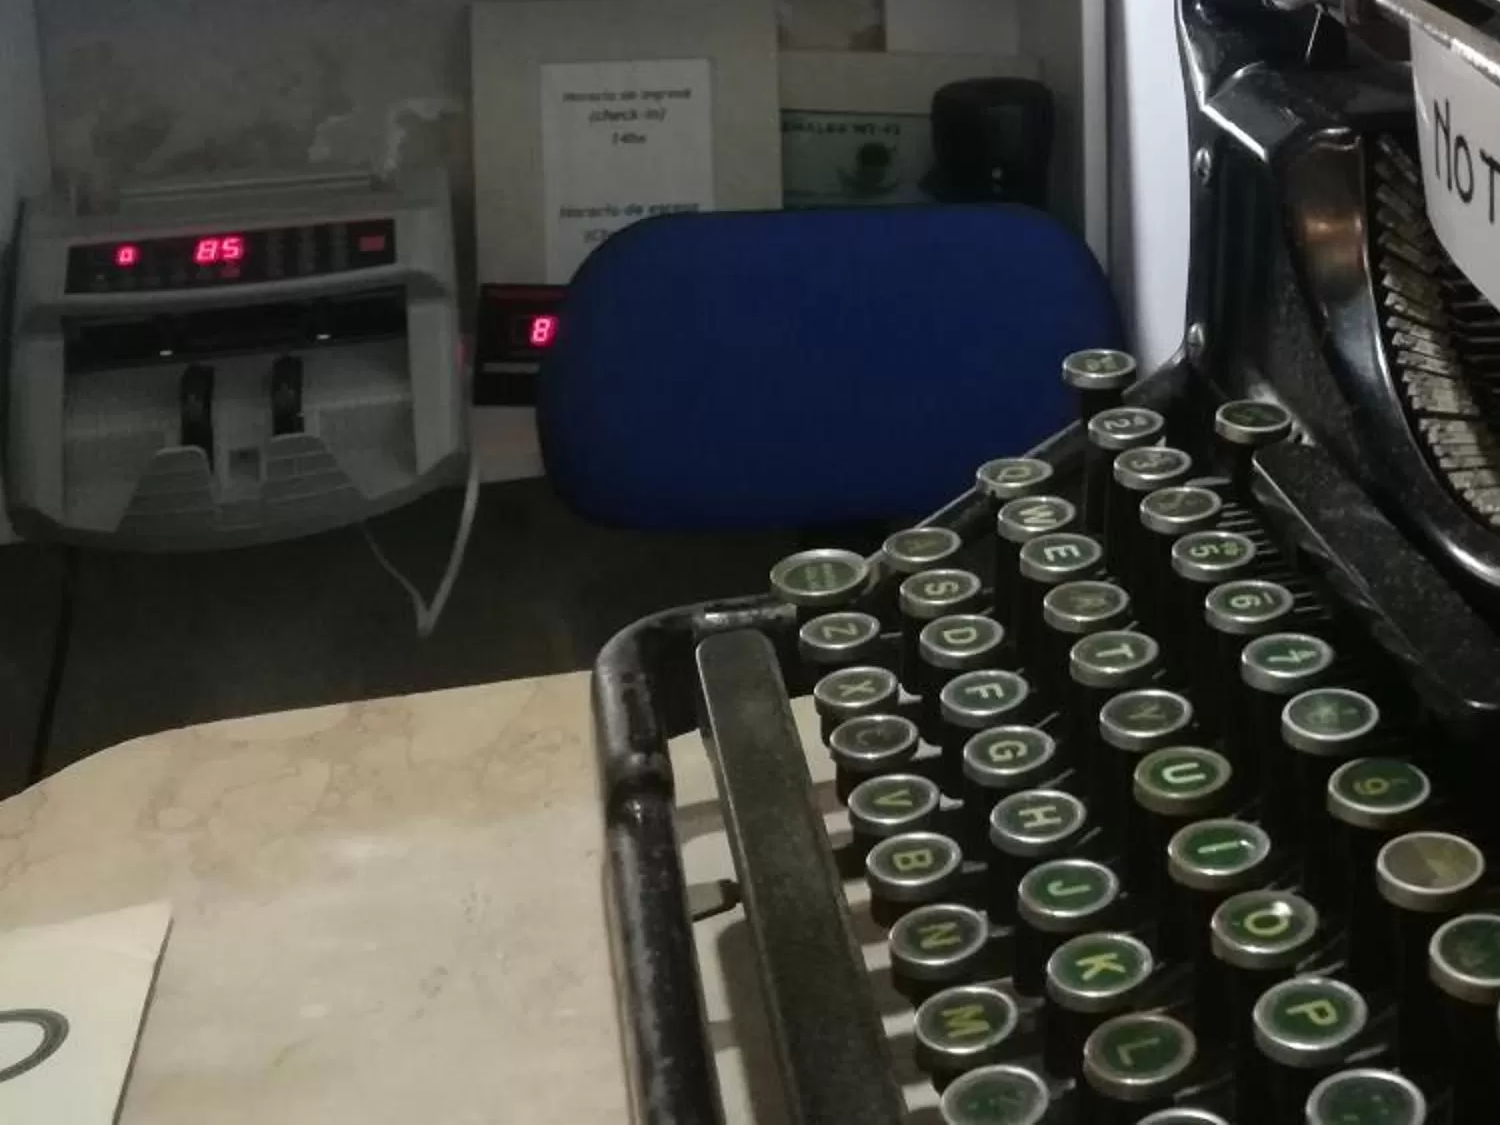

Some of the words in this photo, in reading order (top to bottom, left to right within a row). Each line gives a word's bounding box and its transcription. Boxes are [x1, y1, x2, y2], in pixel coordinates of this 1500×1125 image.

[1433, 97, 1476, 205] NO
[195, 236, 244, 263] 85
[531, 316, 557, 345] 8
[1043, 543, 1082, 562] E
[965, 682, 1004, 700] F
[988, 739, 1029, 763] G
[1161, 761, 1207, 785] U
[873, 788, 913, 807] V
[1018, 805, 1062, 828] H
[892, 848, 934, 871] B
[917, 921, 962, 949] N
[1075, 952, 1127, 982] K
[941, 1003, 991, 1038] M
[1285, 999, 1338, 1026] P
[1115, 1036, 1160, 1068] L
